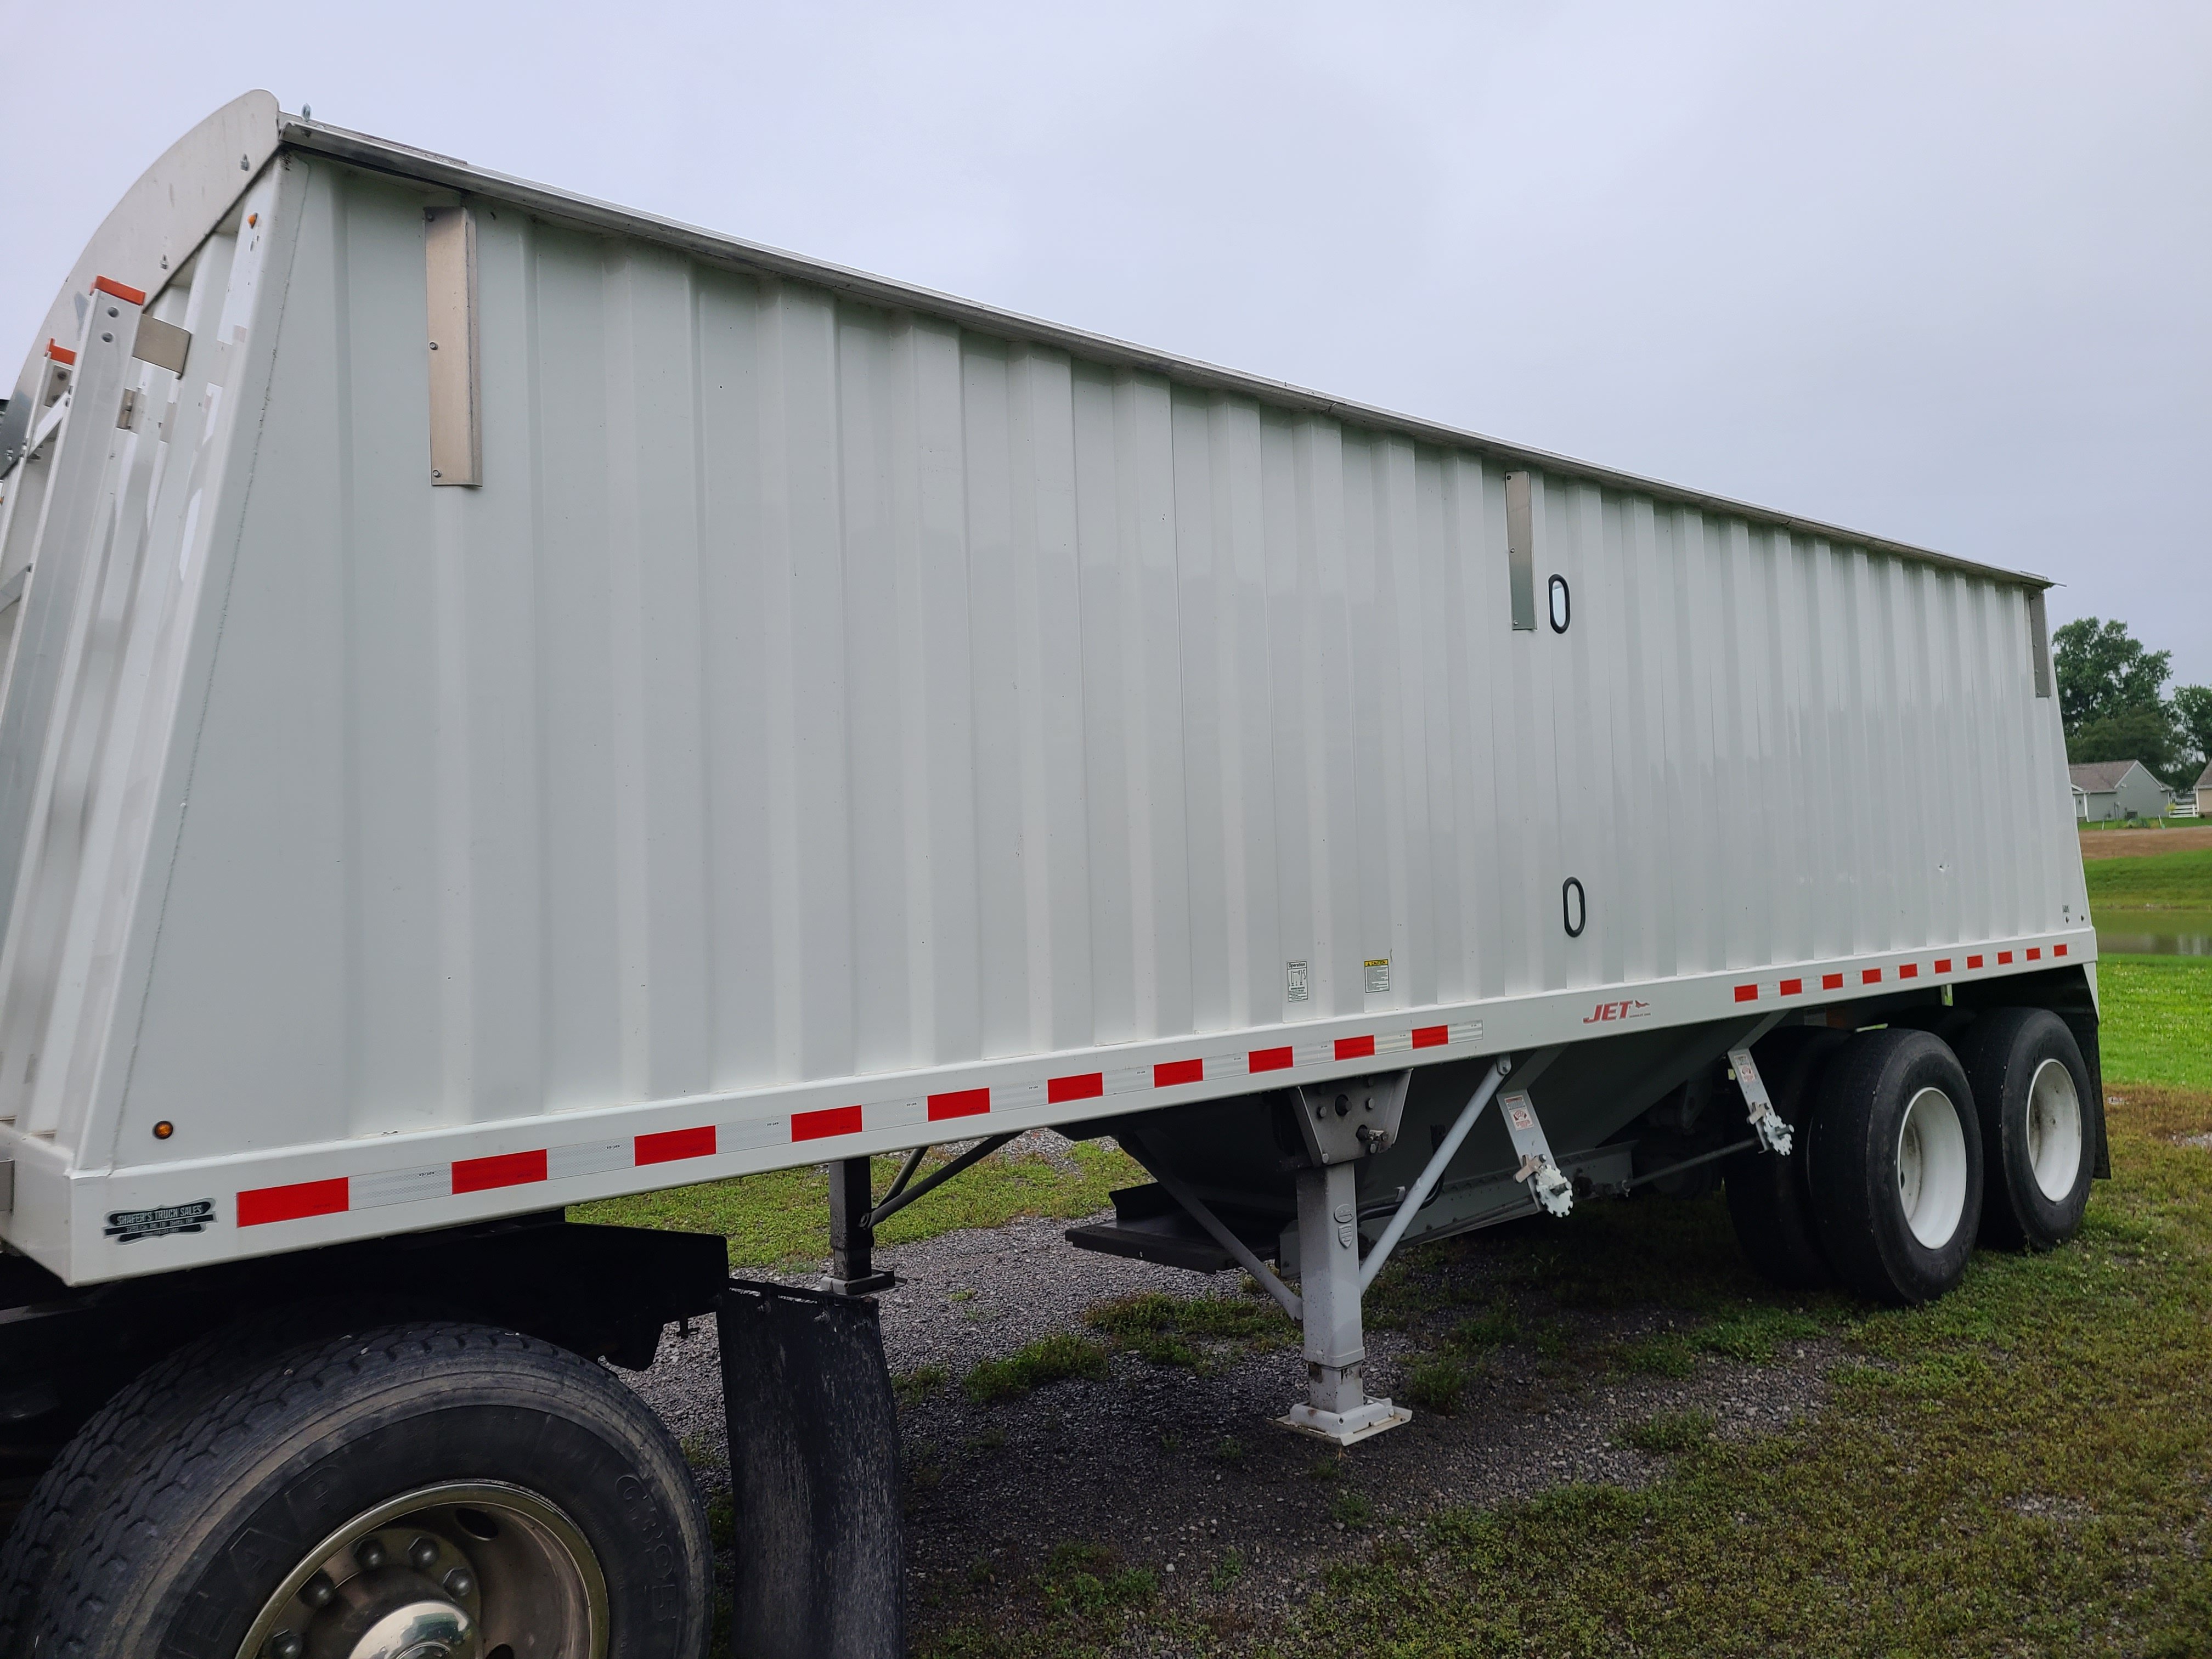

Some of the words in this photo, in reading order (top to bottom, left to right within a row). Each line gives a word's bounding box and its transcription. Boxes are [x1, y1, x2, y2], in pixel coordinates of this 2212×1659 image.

[1583, 1000, 1633, 1024] JET
[117, 1212, 152, 1225] SHAFER'S
[154, 1208, 178, 1220] TRUCK
[180, 1205, 202, 1216] SALES
